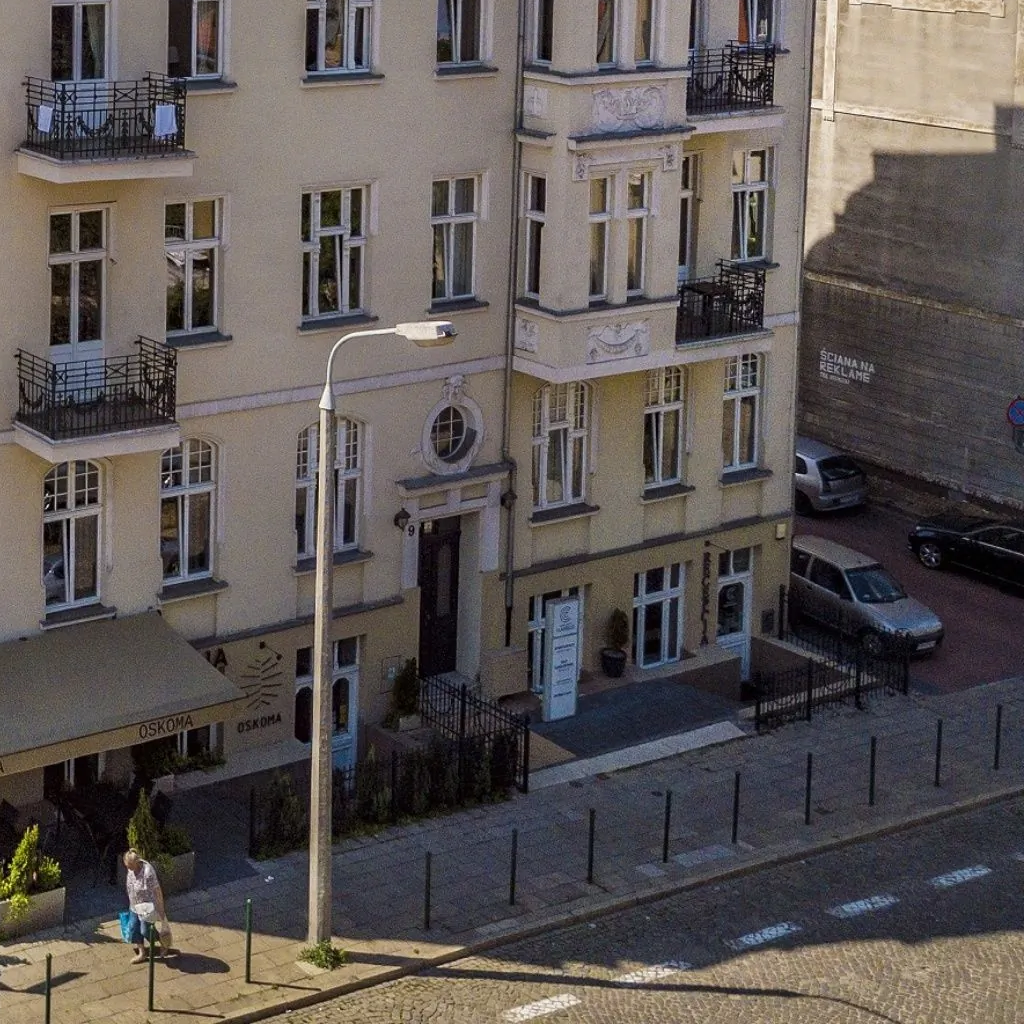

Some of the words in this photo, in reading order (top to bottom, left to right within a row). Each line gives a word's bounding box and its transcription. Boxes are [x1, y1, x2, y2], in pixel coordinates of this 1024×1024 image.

[820, 347, 858, 369] ŚCIANA
[860, 361, 876, 374] NA
[408, 524, 415, 537] 9
[139, 714, 194, 739] OSKOMA
[237, 713, 282, 734] OSKOMA
